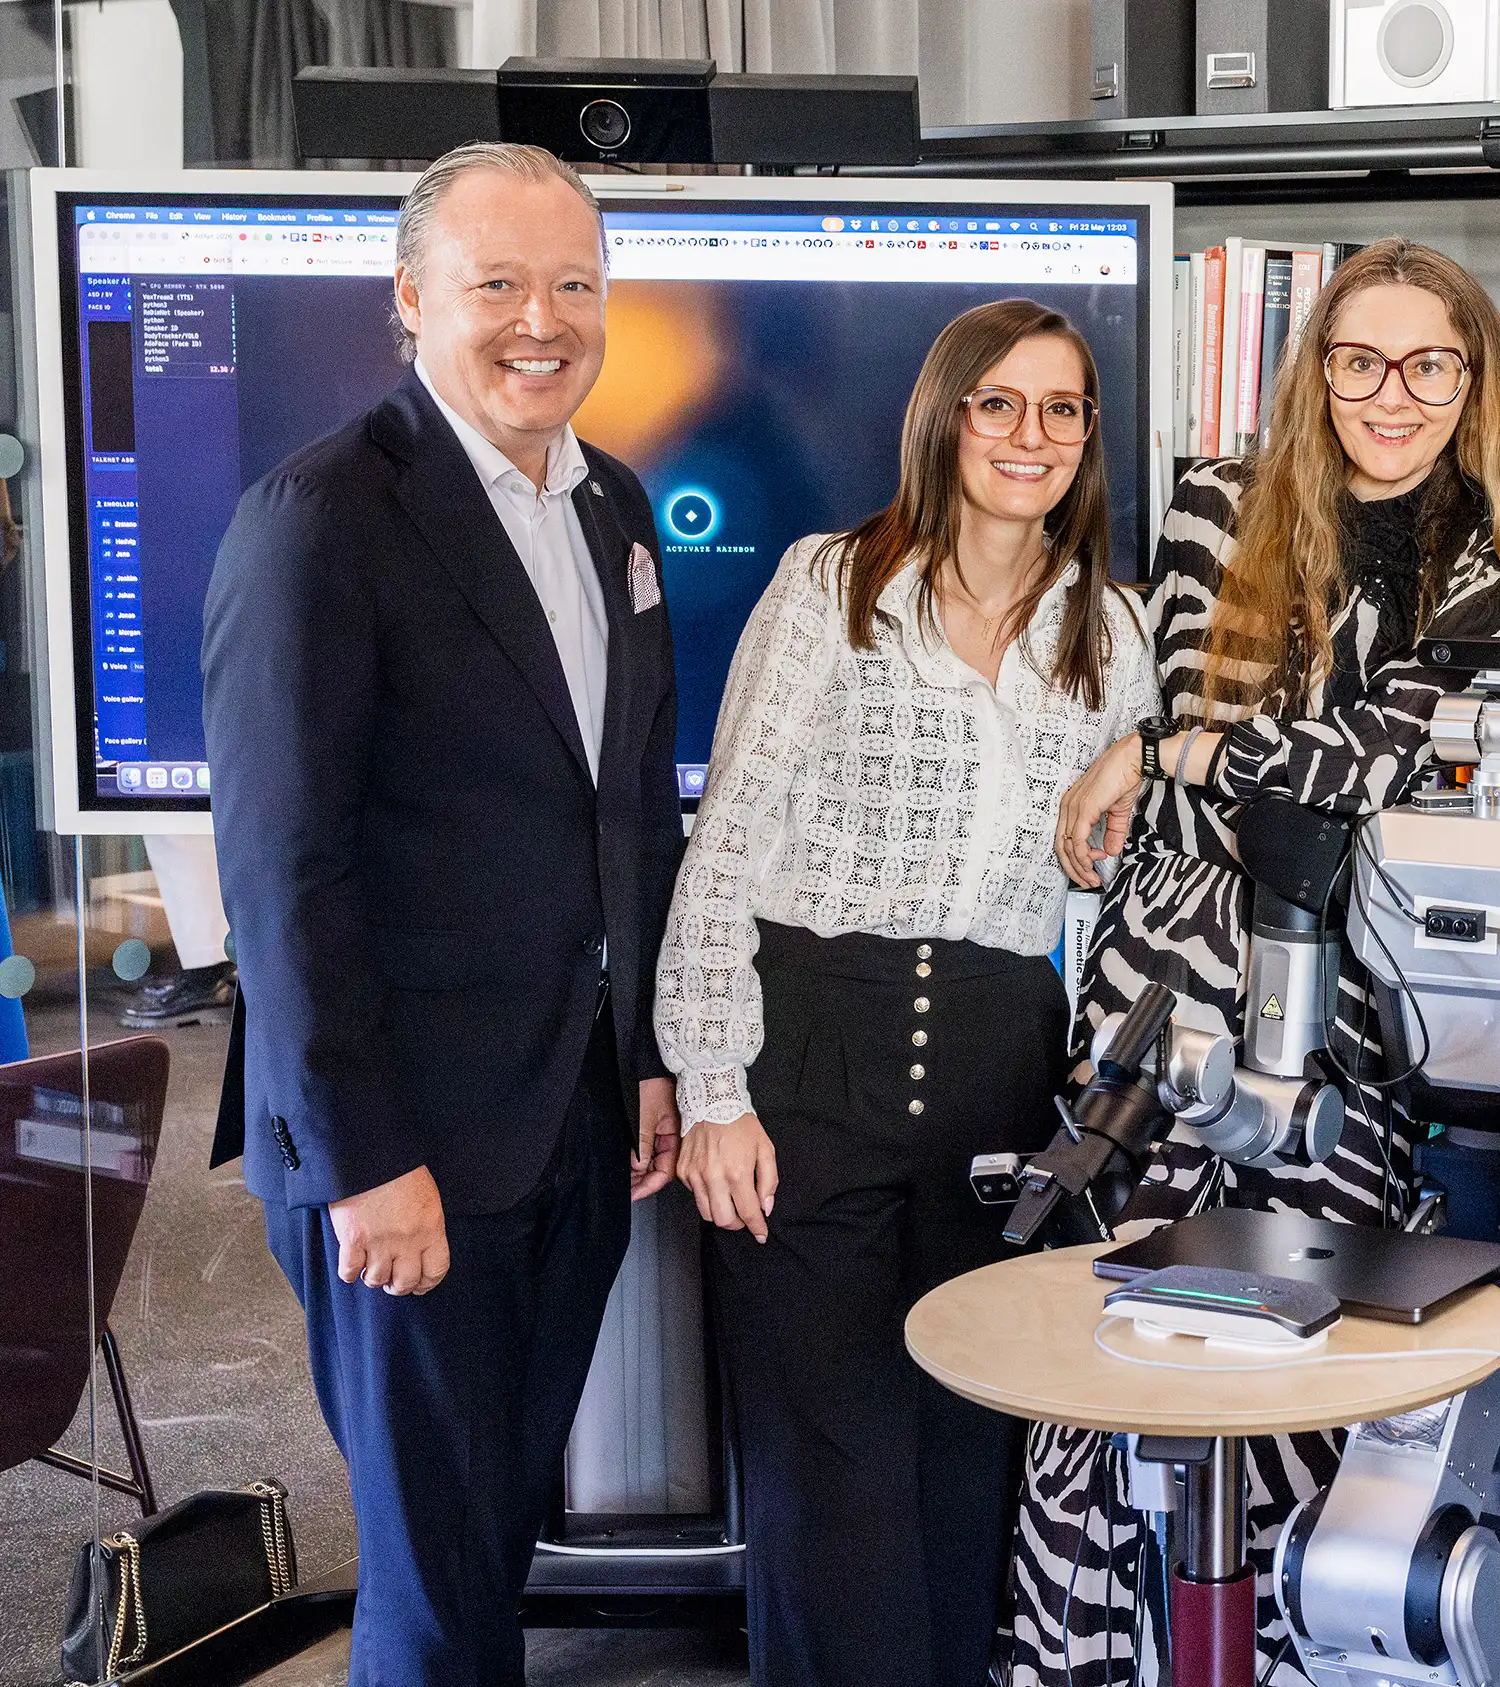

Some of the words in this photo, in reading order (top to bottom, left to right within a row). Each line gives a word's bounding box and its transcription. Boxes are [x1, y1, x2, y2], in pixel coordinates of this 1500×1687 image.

[106, 212, 136, 220] Chrome
[146, 212, 158, 220] File
[169, 212, 184, 220] Edit
[194, 212, 212, 220] View
[222, 212, 248, 222] History
[258, 214, 296, 222] Bookmarks
[306, 214, 334, 222] Profiles
[344, 214, 357, 222] Tab
[367, 214, 395, 222] Window
[1069, 223, 1079, 231] Fri
[1090, 224, 1106, 232] May
[1107, 224, 1127, 232] 12:03
[88, 278, 120, 286] Speaker
[1206, 304, 1219, 346] Sensation
[144, 348, 166, 356] python
[144, 356, 170, 364] python3
[1204, 365, 1216, 424] Measurement
[122, 696, 144, 704] gallery
[120, 738, 142, 746] gallery
[1076, 919, 1085, 974] Phonetic
